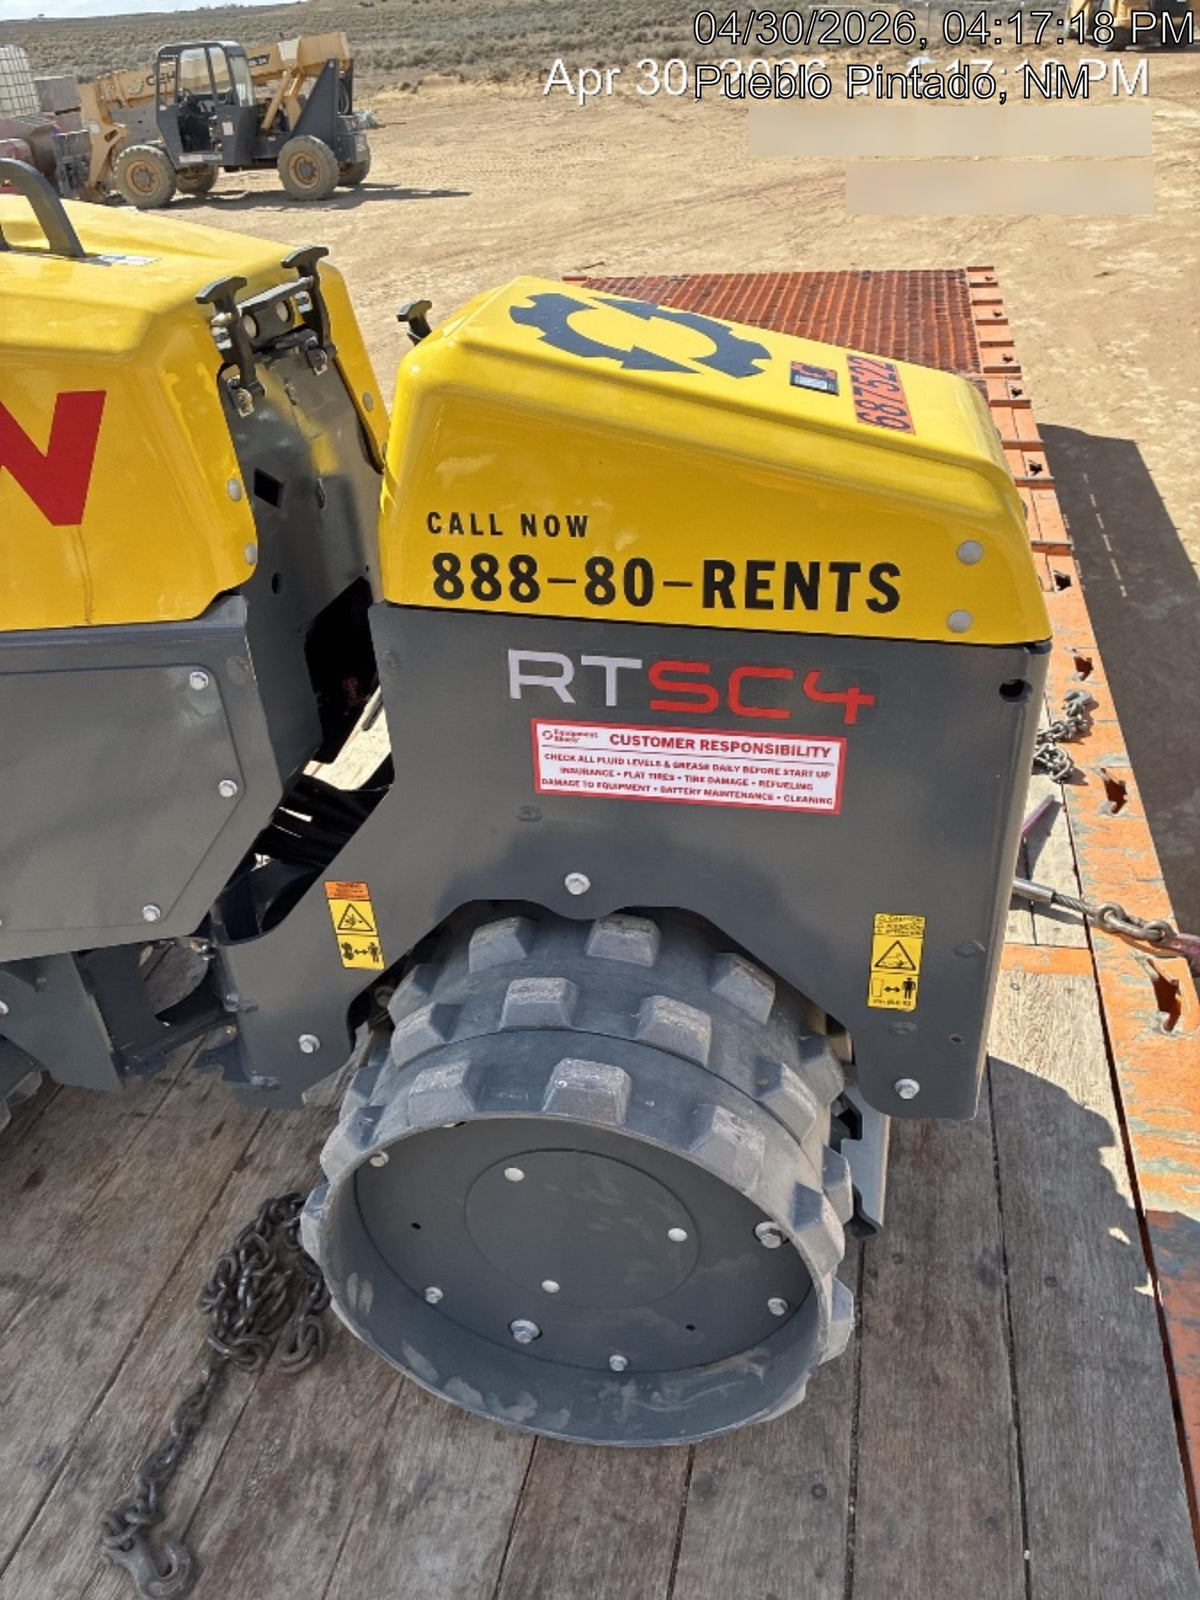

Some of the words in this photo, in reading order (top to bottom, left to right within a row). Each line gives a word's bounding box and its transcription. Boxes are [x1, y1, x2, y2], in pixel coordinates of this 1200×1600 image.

[427, 511, 504, 537] CALL
[522, 513, 590, 539] NOW
[432, 552, 901, 613] 888-80-RENTS
[609, 733, 695, 750] CUSTOMER
[700, 739, 832, 758] RESPONSIBILITY
[544, 753, 575, 761] CHECK
[578, 755, 596, 764] ALL
[597, 757, 625, 765] FLUID
[627, 758, 661, 768] LEVELS
[662, 760, 671, 769] &
[672, 761, 709, 771] GREASE
[712, 763, 741, 773] DAILY
[742, 765, 781, 776] BEFORE
[783, 768, 814, 778] START
[815, 770, 832, 779] UP
[560, 767, 614, 778] INSURANCE
[623, 770, 645, 780] FLAT
[648, 772, 675, 781] TIRES
[684, 774, 706, 783] TIRE
[707, 775, 749, 786] DAMAGE
[758, 780, 814, 791] REFUELING
[541, 778, 581, 788] DAMAGE
[582, 780, 595, 789] TO
[596, 781, 651, 792] EQUIPMENT
[660, 785, 702, 796] BATTERY
[703, 788, 774, 800] MAINTENANCE
[783, 793, 833, 805] CLEANING
